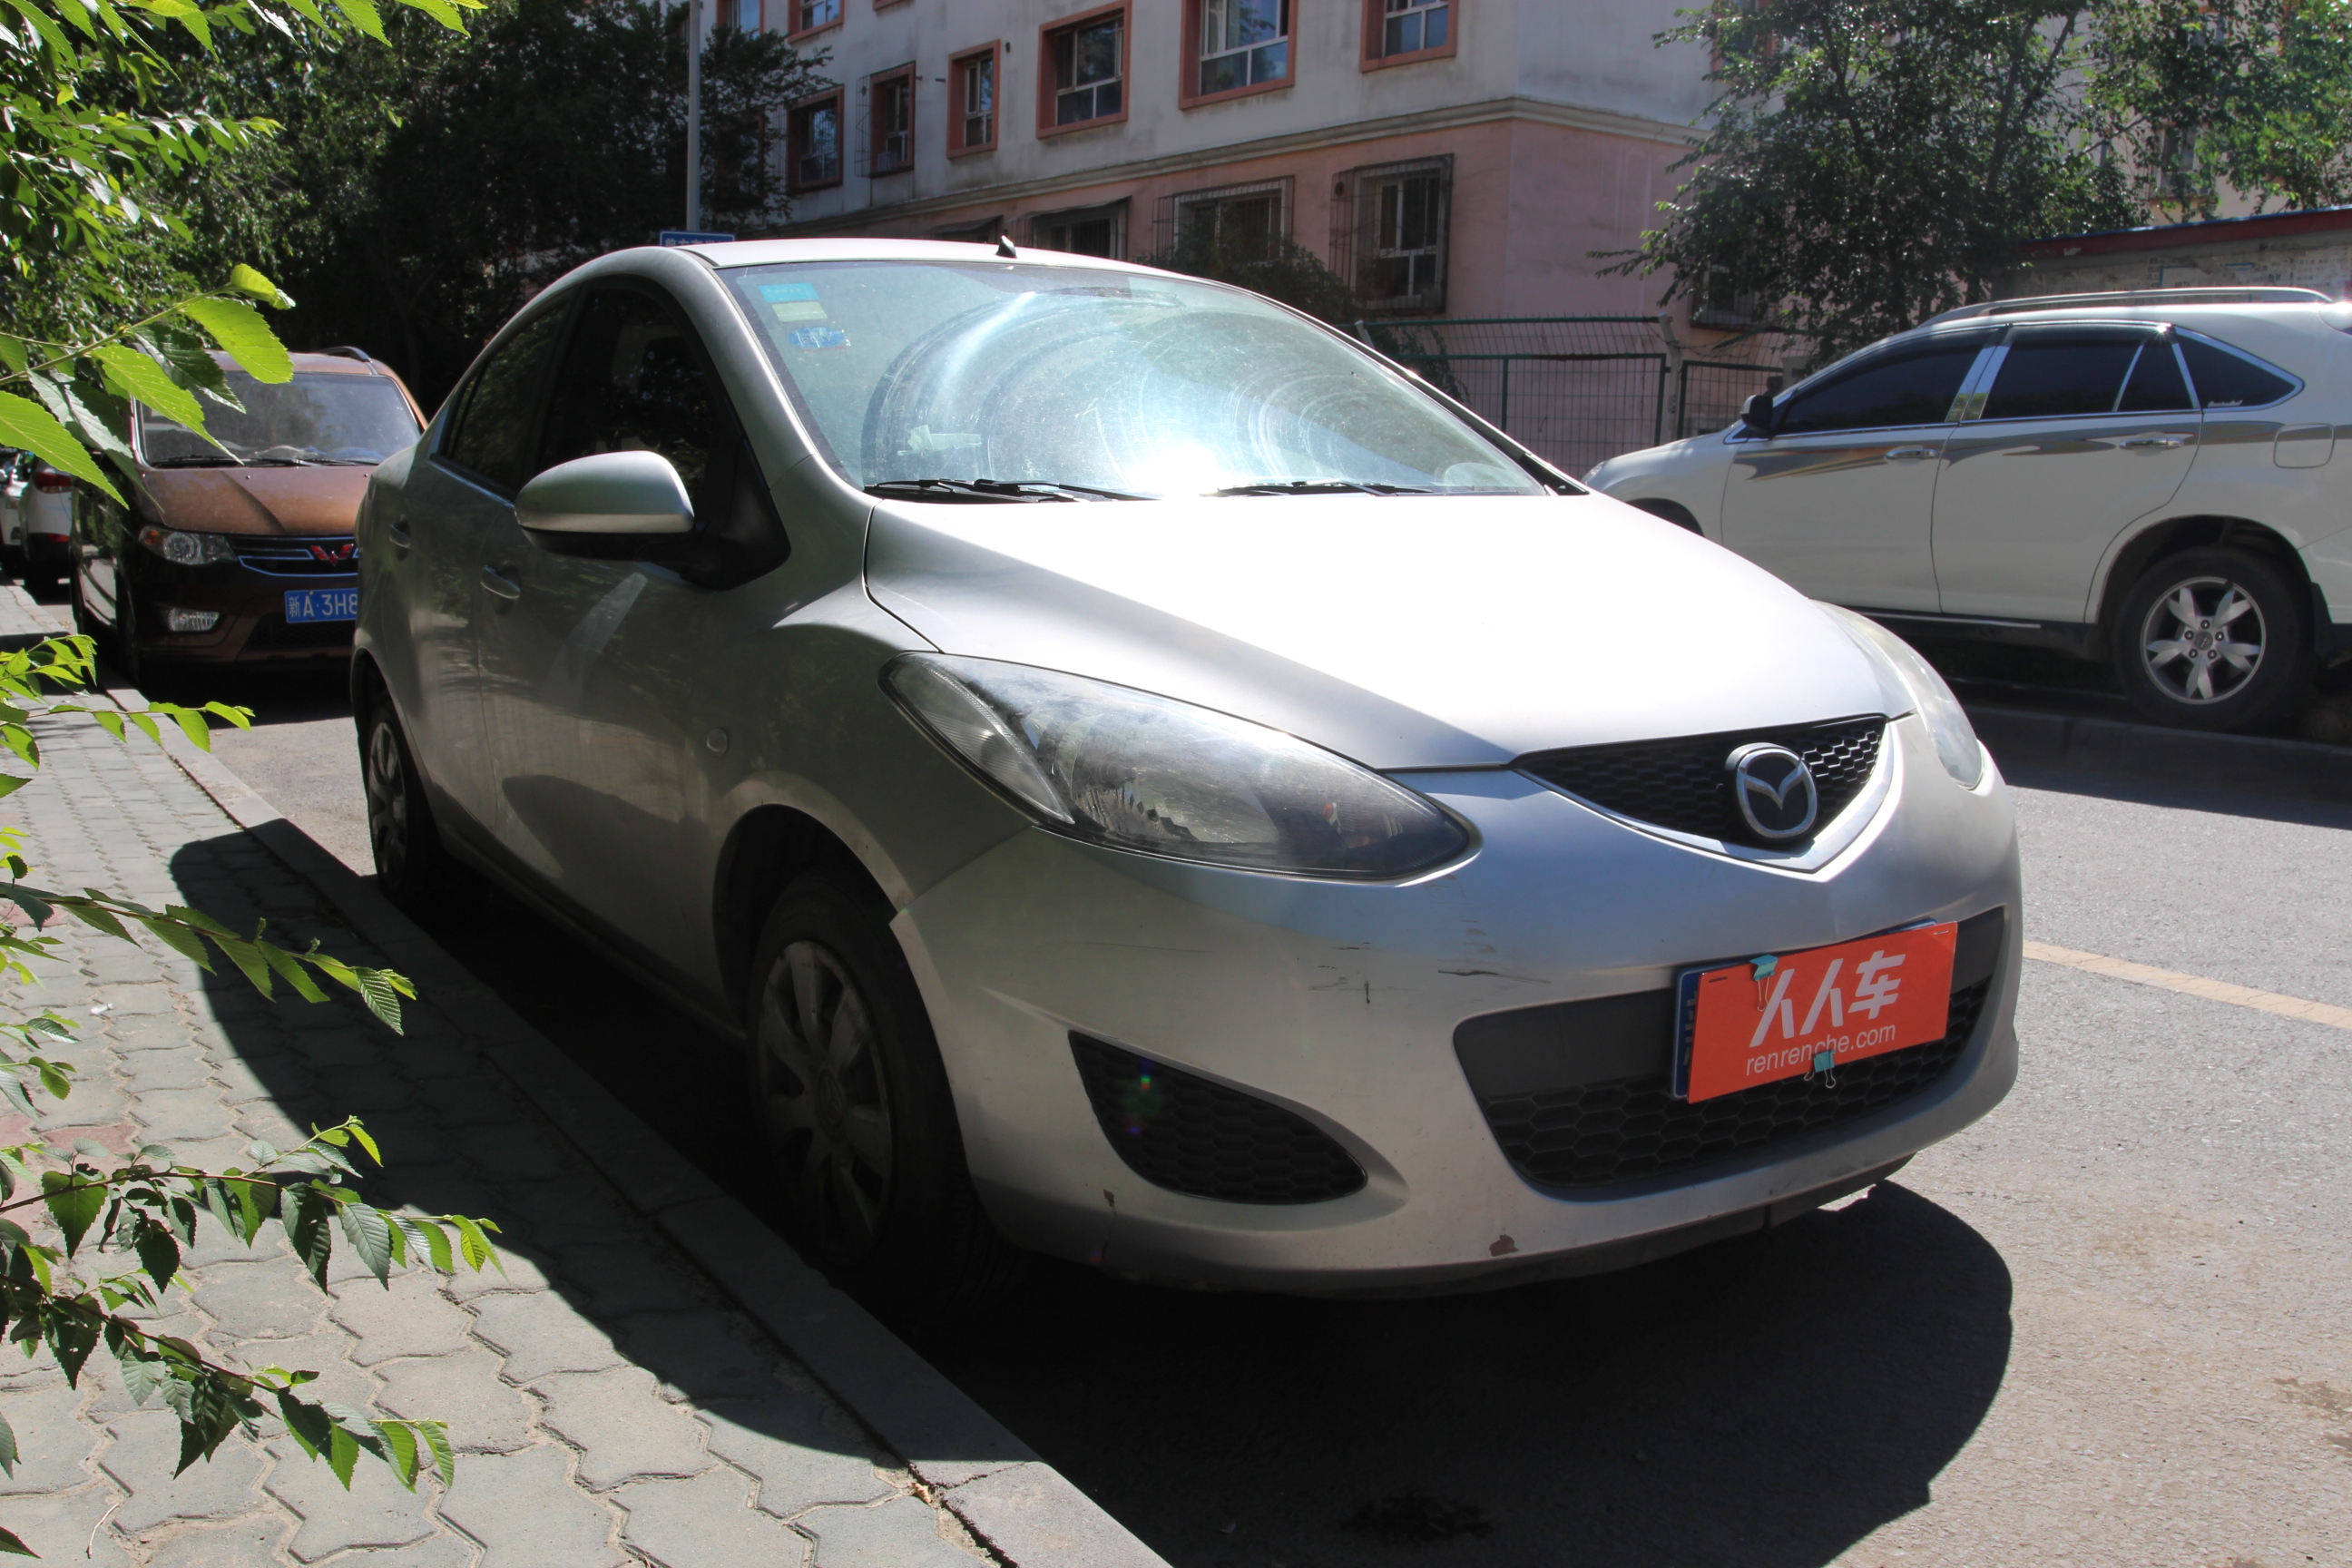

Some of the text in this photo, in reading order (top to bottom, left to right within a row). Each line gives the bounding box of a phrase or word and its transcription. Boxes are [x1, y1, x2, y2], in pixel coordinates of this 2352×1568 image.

[1749, 950, 1906, 1048] 人人车
[1746, 1024, 1896, 1076] renrenche.com
